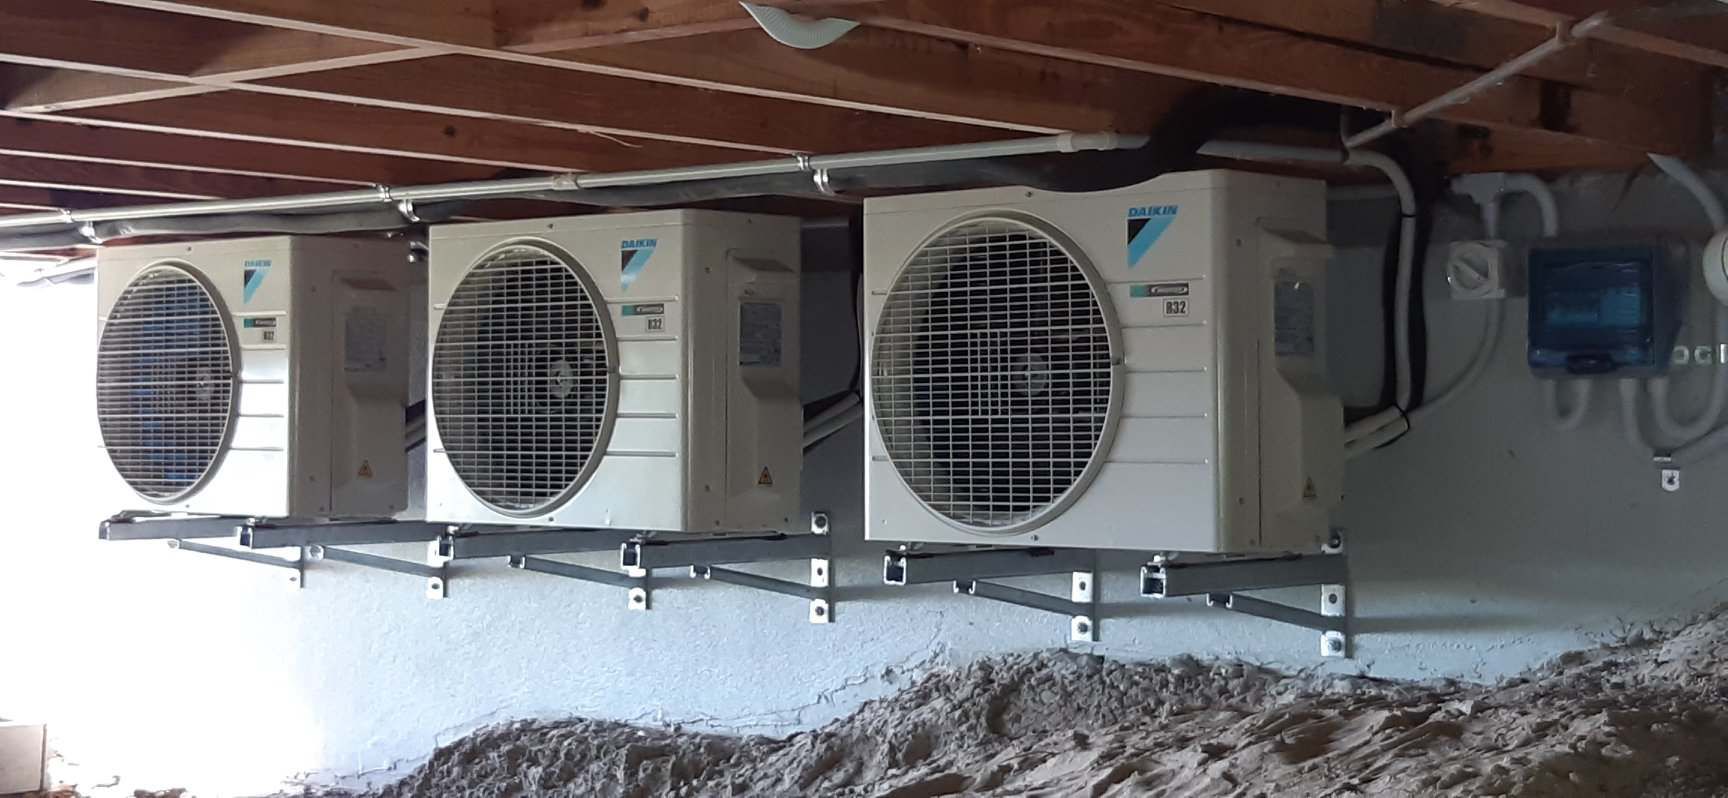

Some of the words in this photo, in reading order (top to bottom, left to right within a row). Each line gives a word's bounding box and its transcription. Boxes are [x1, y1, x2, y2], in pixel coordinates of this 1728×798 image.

[1128, 205, 1178, 217] DAIKIN
[621, 239, 657, 249] DAIKIN
[1166, 301, 1186, 315] R32
